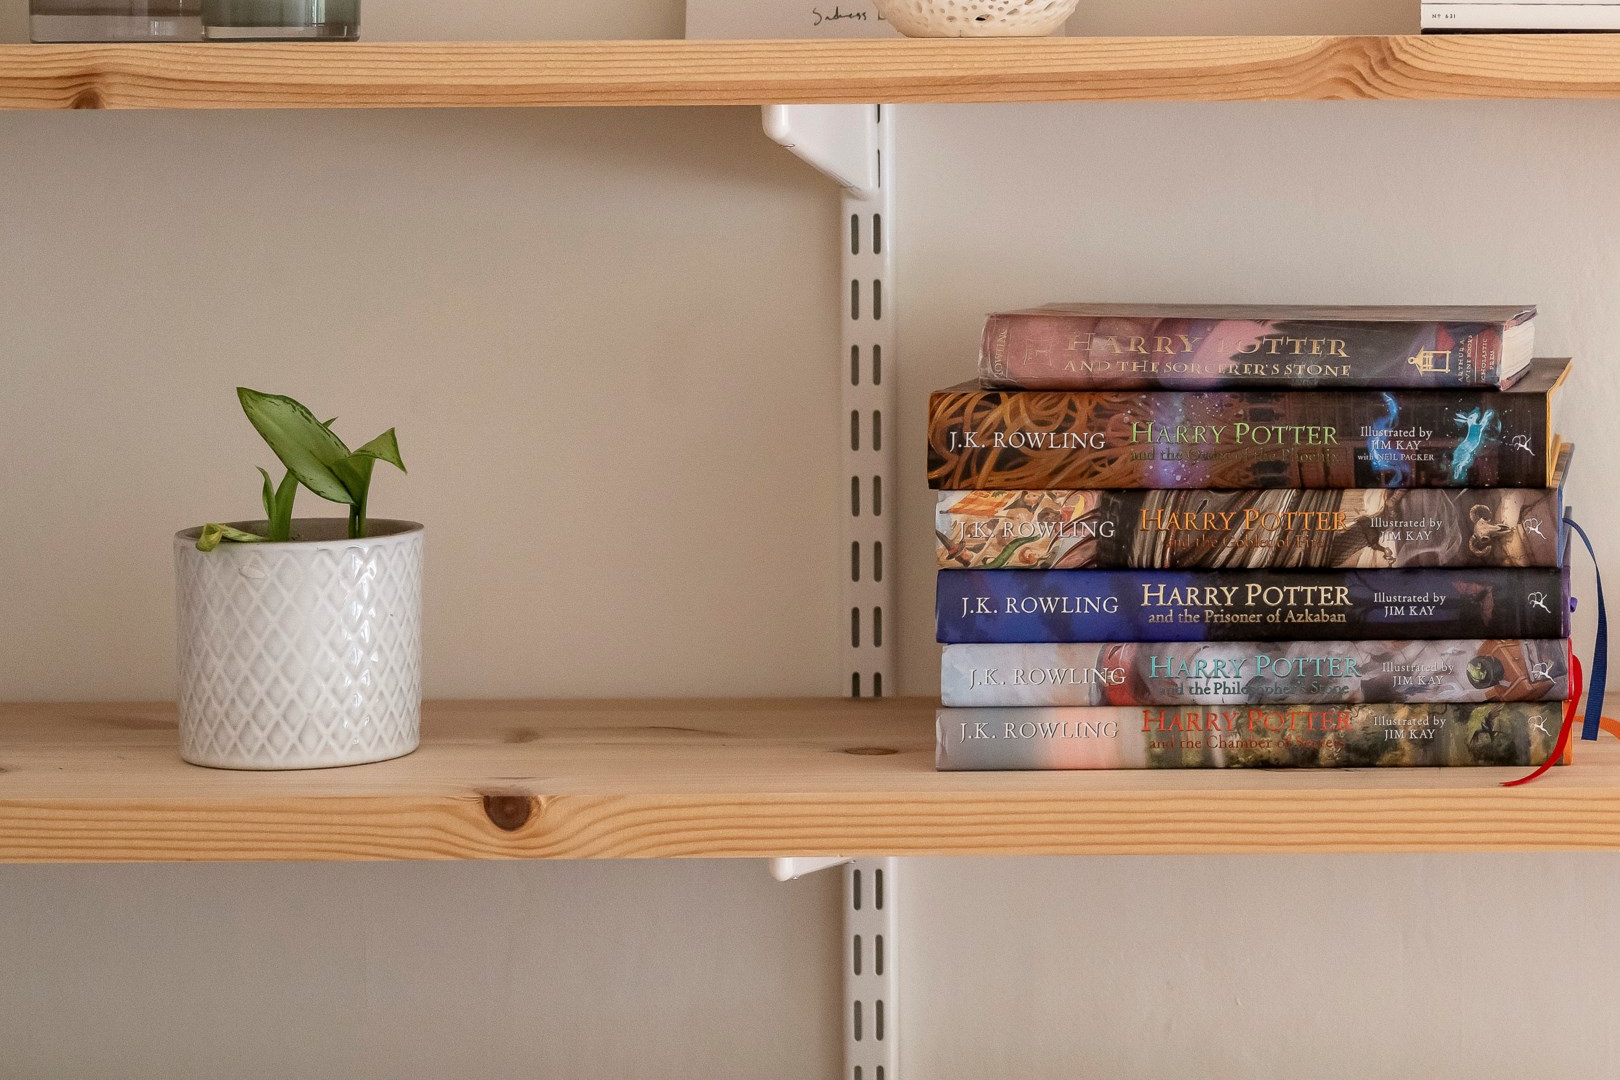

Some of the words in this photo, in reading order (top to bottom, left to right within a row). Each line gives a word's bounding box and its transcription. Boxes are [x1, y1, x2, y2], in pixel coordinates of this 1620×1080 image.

[1067, 332, 1201, 355] HARRY
[1217, 334, 1351, 358] POTTER
[1064, 360, 1112, 372] AND
[1117, 361, 1158, 372] THE
[1165, 361, 1280, 376] SORCERER'S
[1284, 364, 1350, 377] STONE
[950, 431, 984, 452] J.K.
[994, 432, 1106, 449] ROWLING
[1131, 421, 1227, 444] HARRY
[1234, 423, 1340, 445] POTTER
[1361, 427, 1415, 438] Illustrated
[1419, 427, 1432, 441] by
[1370, 440, 1393, 452] JIM
[1396, 440, 1421, 451] KAY
[1140, 508, 1237, 531] HARRY
[1243, 509, 1347, 531] POTTER
[1370, 518, 1426, 528] Illustrated
[1429, 518, 1442, 530] by
[959, 521, 994, 539] J.K.
[1002, 521, 1116, 538] ROWLING
[1379, 531, 1401, 542] JIM
[1406, 531, 1432, 541] KAY
[1141, 583, 1238, 607] HARRY
[1245, 583, 1353, 607] POTTER
[1374, 593, 1430, 603] Illustrated
[1433, 593, 1447, 606] by
[961, 597, 998, 619] J.K.
[1005, 597, 1119, 614] ROWLING
[1149, 610, 1173, 623] and
[1178, 610, 1200, 623] the
[1204, 610, 1264, 623] Prisoner
[1267, 610, 1282, 623] of
[1285, 610, 1346, 623] Azkaban
[1384, 606, 1405, 618] JIM
[1409, 606, 1436, 616] KAY
[1149, 655, 1248, 679] HARRY
[1254, 654, 1362, 678] POTTER
[1382, 662, 1438, 673] Illustrated
[1441, 662, 1455, 676] by
[969, 668, 1005, 690] J.K.
[1013, 667, 1127, 685] ROWLING
[1392, 676, 1413, 688] JIM
[1417, 675, 1444, 686] KAY
[1141, 709, 1239, 732] HARRY
[1248, 709, 1353, 731] POTTER
[1374, 716, 1430, 727] Illustrated
[1433, 716, 1447, 729] by
[959, 722, 997, 743] J.K.
[1003, 721, 1120, 739] ROWLING
[1384, 729, 1405, 741] JIM
[1409, 729, 1436, 739] KAY
